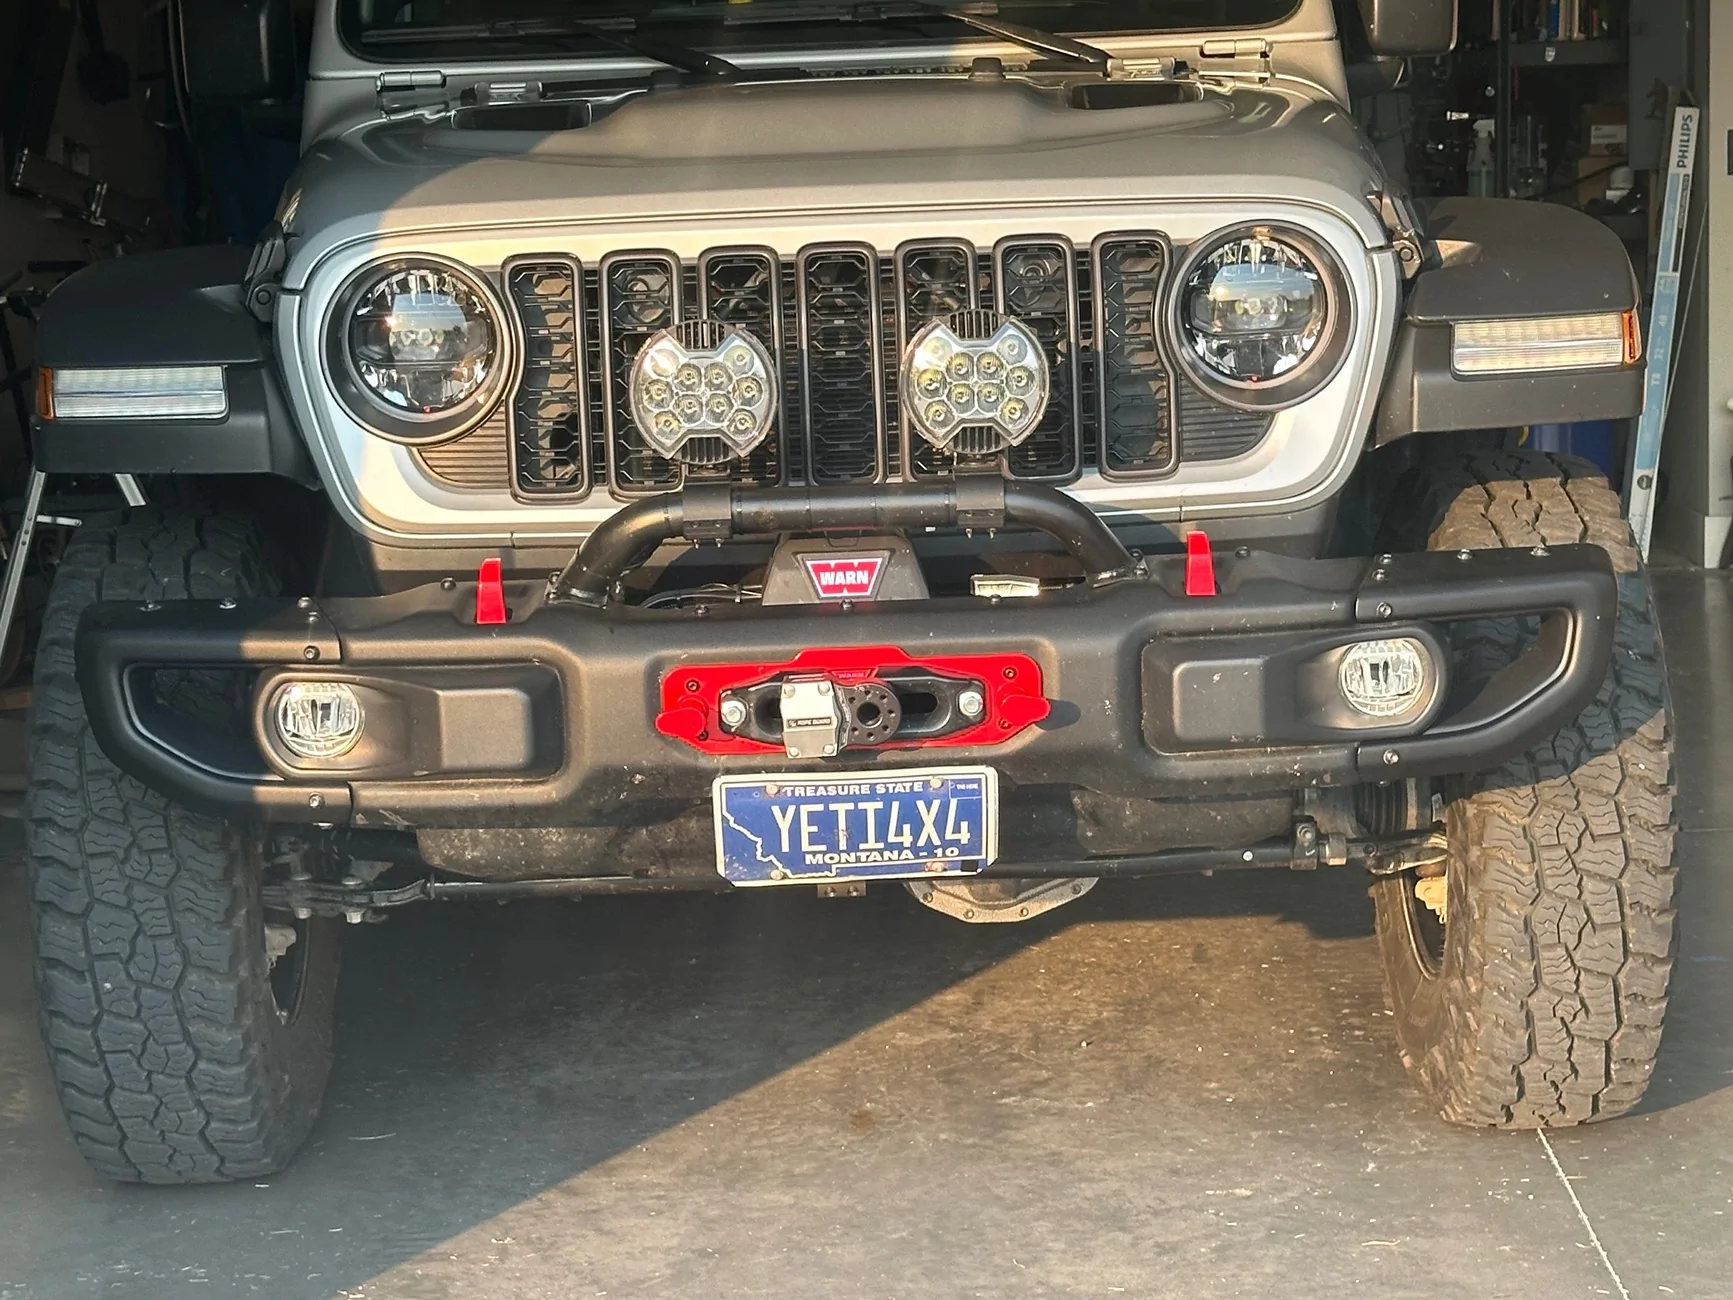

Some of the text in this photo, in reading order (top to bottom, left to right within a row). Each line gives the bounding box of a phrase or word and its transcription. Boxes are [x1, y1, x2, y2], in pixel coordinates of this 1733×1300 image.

[1677, 114, 1693, 168] PHILIPS
[820, 570, 869, 585] WARN
[784, 781, 924, 797] TREASURE STATE
[771, 799, 971, 853] YETI4X4
[805, 850, 915, 865] MONTANA
[934, 846, 960, 858] 10
